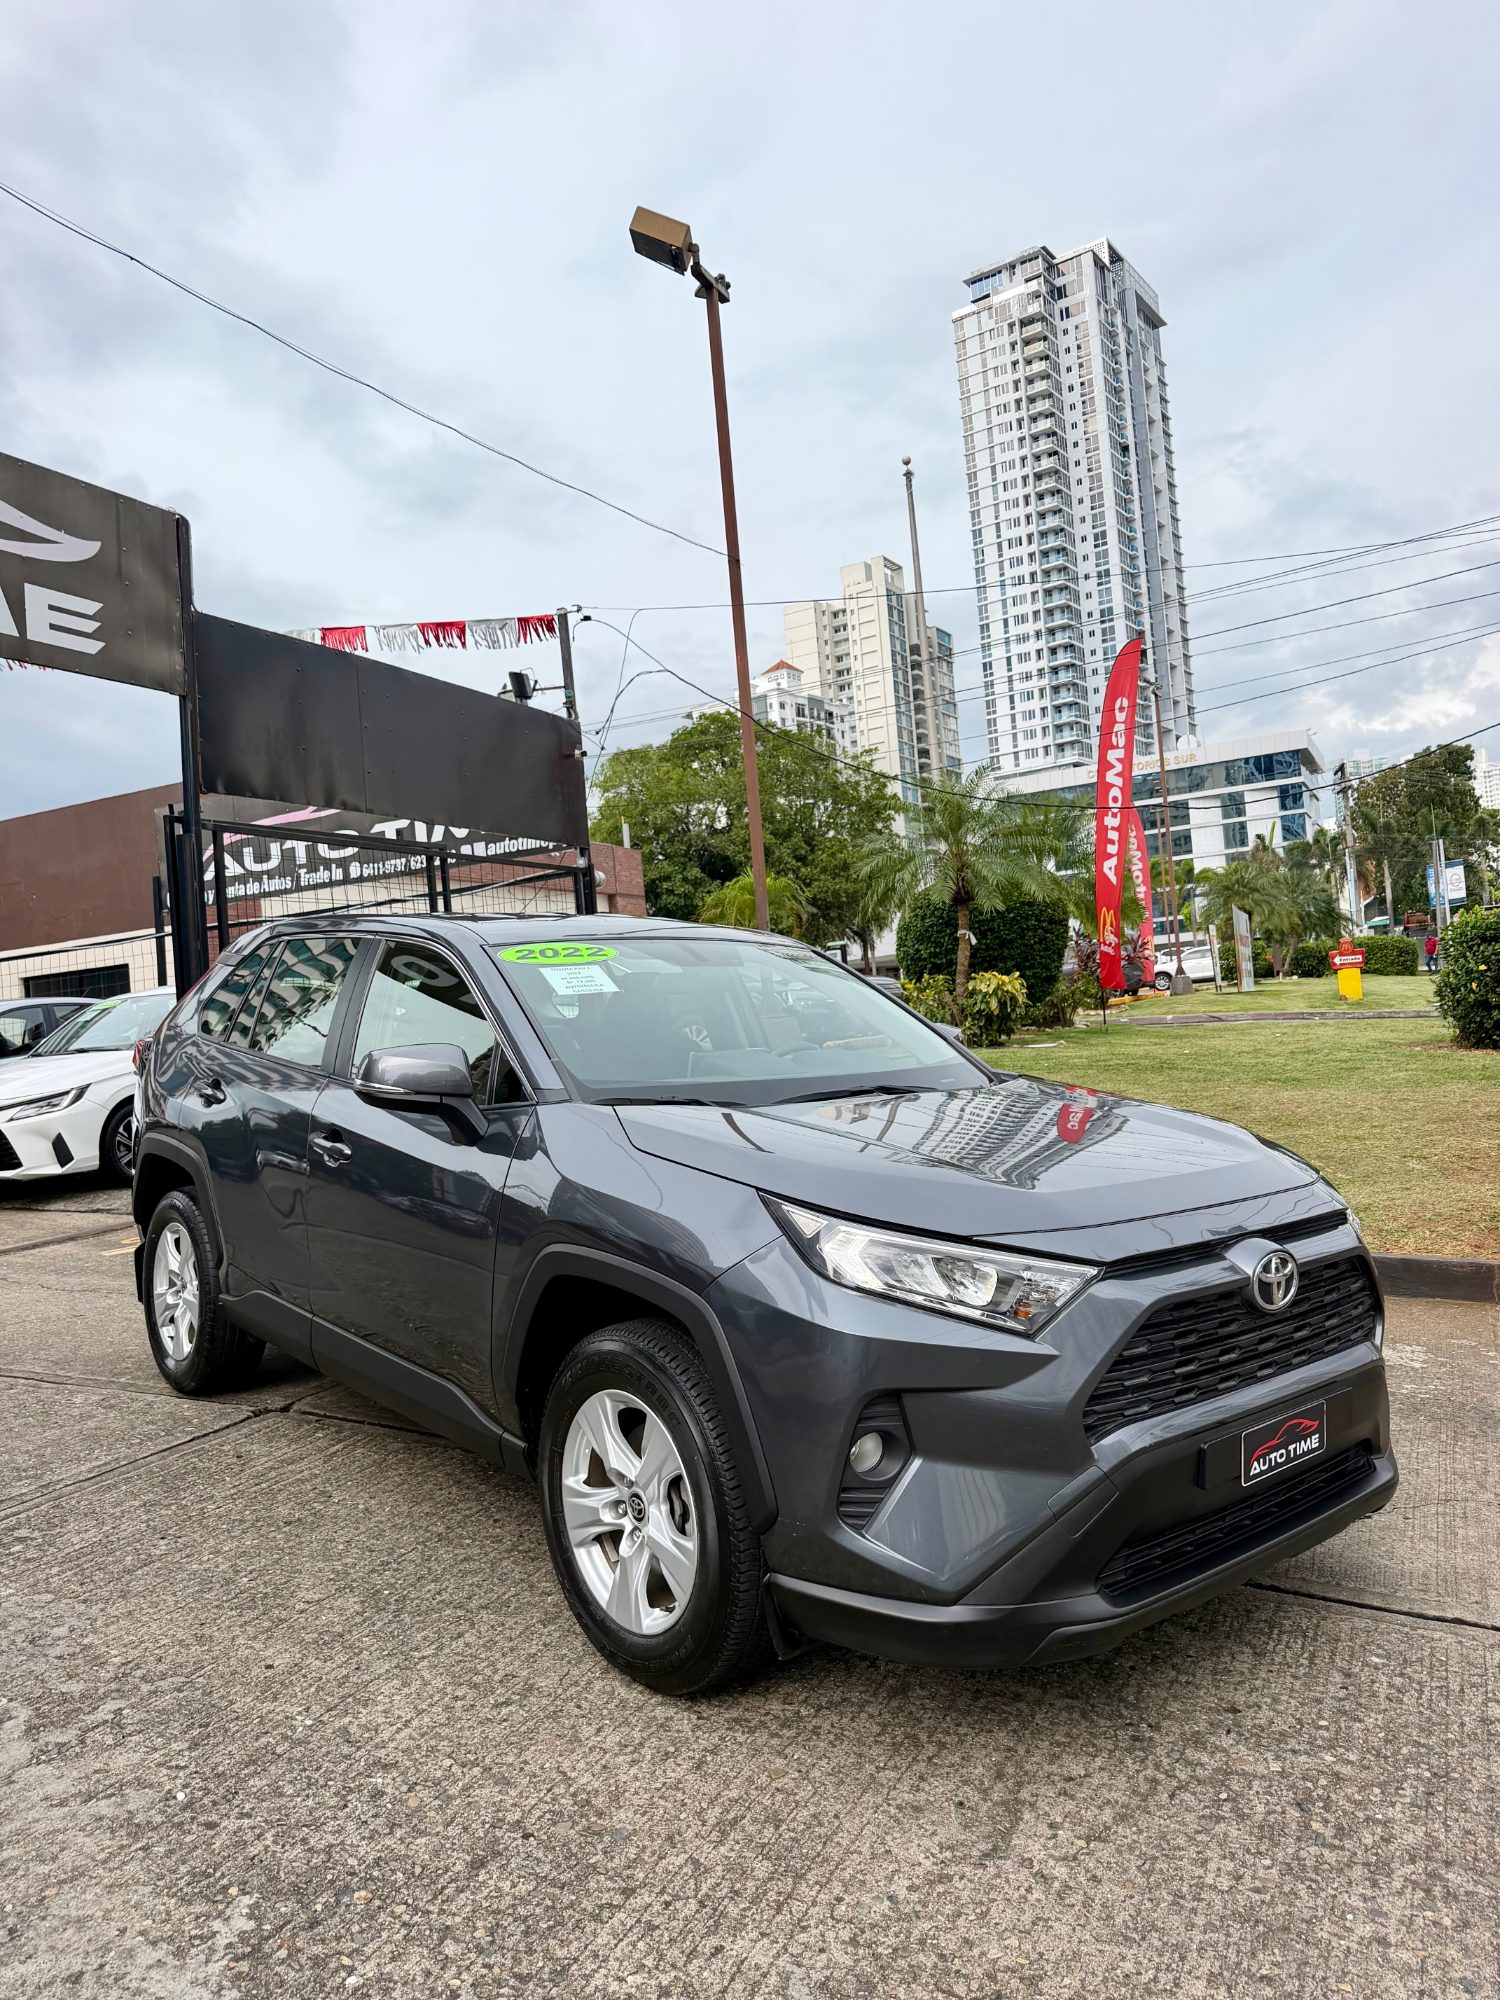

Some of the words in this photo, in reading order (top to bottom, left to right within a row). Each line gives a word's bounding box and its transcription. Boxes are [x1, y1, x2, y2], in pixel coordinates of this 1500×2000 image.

[1173, 752, 1198, 765] SUR
[1103, 696, 1128, 885] AutoMac
[203, 829, 360, 881] AUTO
[246, 877, 260, 895] de
[260, 874, 292, 893] Autos
[298, 865, 331, 886] Trade
[331, 863, 344, 881] In
[362, 857, 406, 877] 6411-9797
[514, 946, 609, 960] 2022
[1250, 1449, 1287, 1476] AUTO
[1288, 1433, 1320, 1458] TIME
